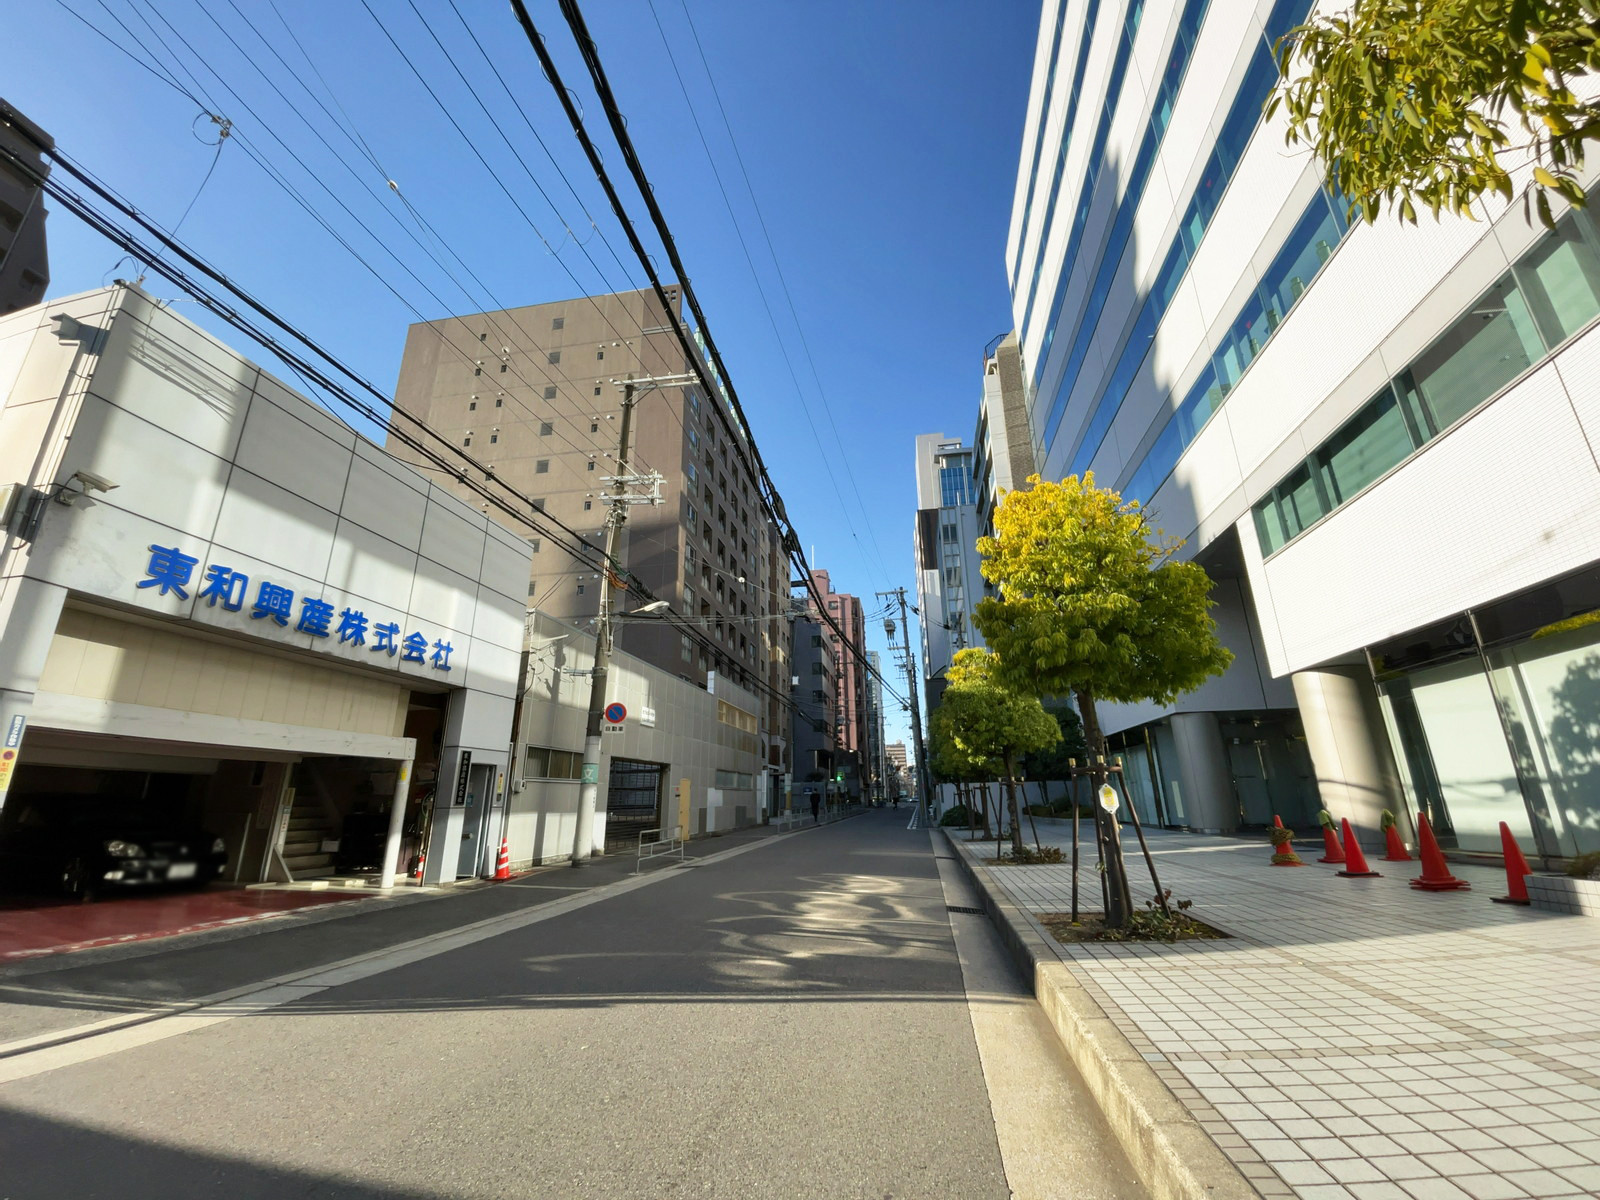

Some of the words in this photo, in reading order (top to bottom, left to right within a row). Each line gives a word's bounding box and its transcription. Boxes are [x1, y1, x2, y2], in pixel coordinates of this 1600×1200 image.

[137, 544, 454, 671] 東和興産株式会社
